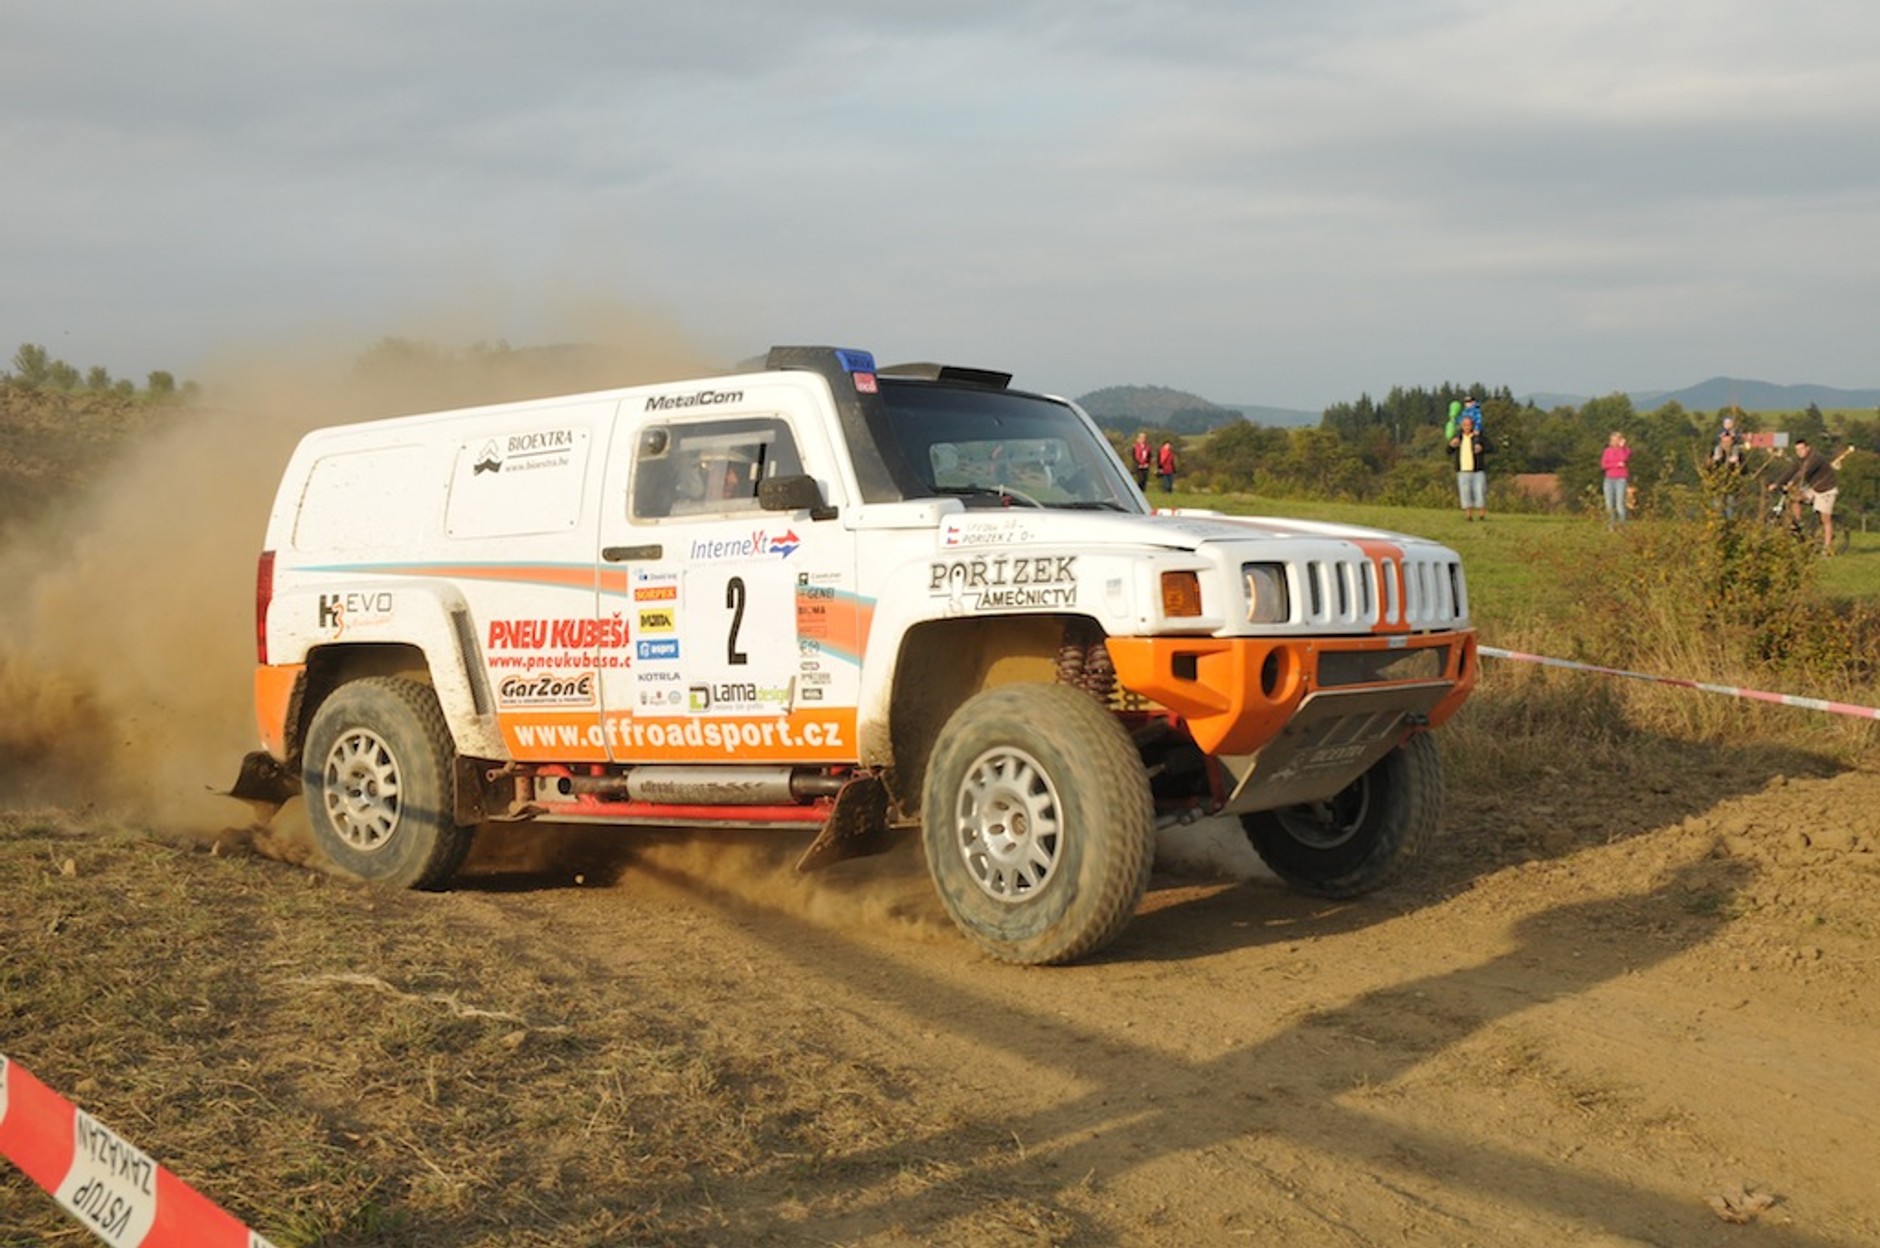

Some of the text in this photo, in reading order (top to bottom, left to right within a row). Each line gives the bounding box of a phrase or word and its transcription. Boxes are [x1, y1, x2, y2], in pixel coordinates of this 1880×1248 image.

[644, 390, 744, 411] MetalCom
[508, 430, 573, 452] BIOEXTRA
[929, 554, 1078, 589] POŘÍZEK
[346, 593, 392, 612] EVO
[488, 620, 548, 650] PNEU
[726, 576, 748, 666] 2
[513, 718, 843, 752] www.offroadsport.cz
[73, 1177, 133, 1239] VSTUP
